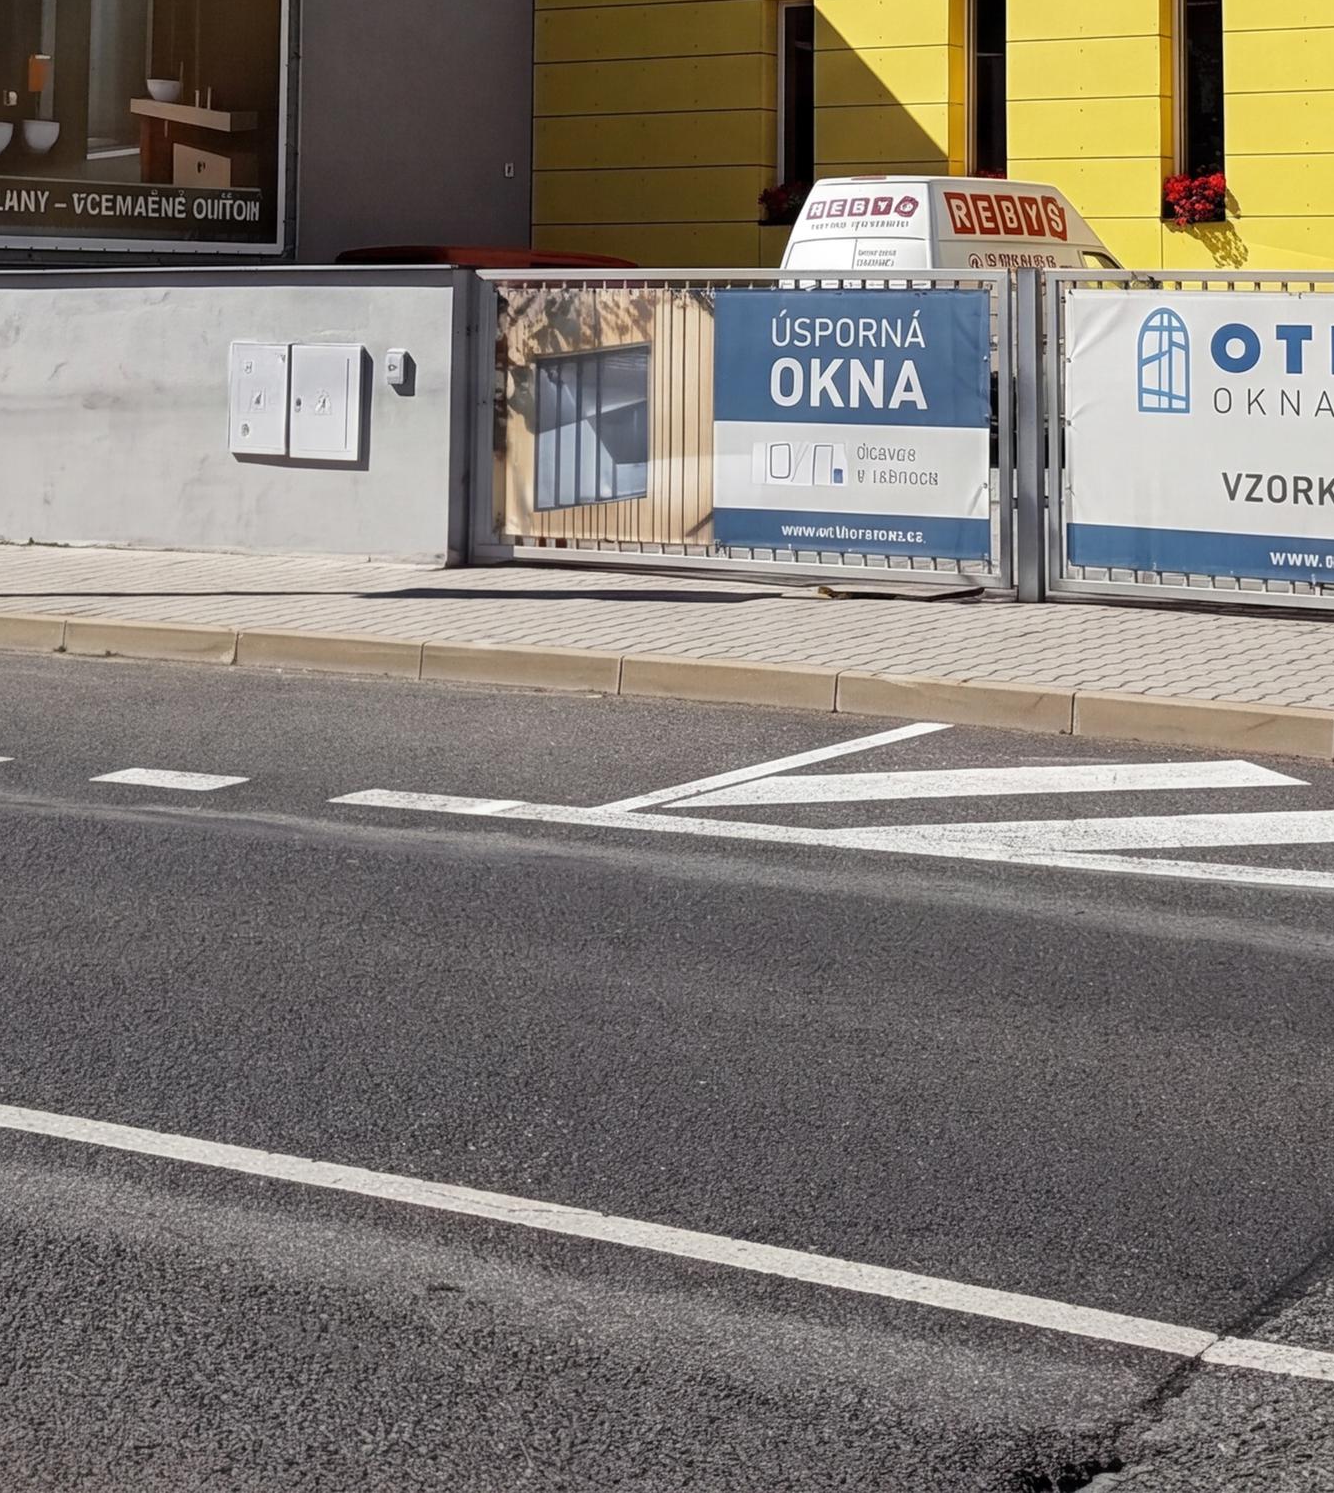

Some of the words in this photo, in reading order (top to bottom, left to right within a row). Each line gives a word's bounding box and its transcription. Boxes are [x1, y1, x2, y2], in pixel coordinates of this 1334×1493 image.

[951, 193, 1065, 238] REBYS
[771, 310, 926, 348] ÚSPORNÁ
[770, 357, 927, 410] OKNA
